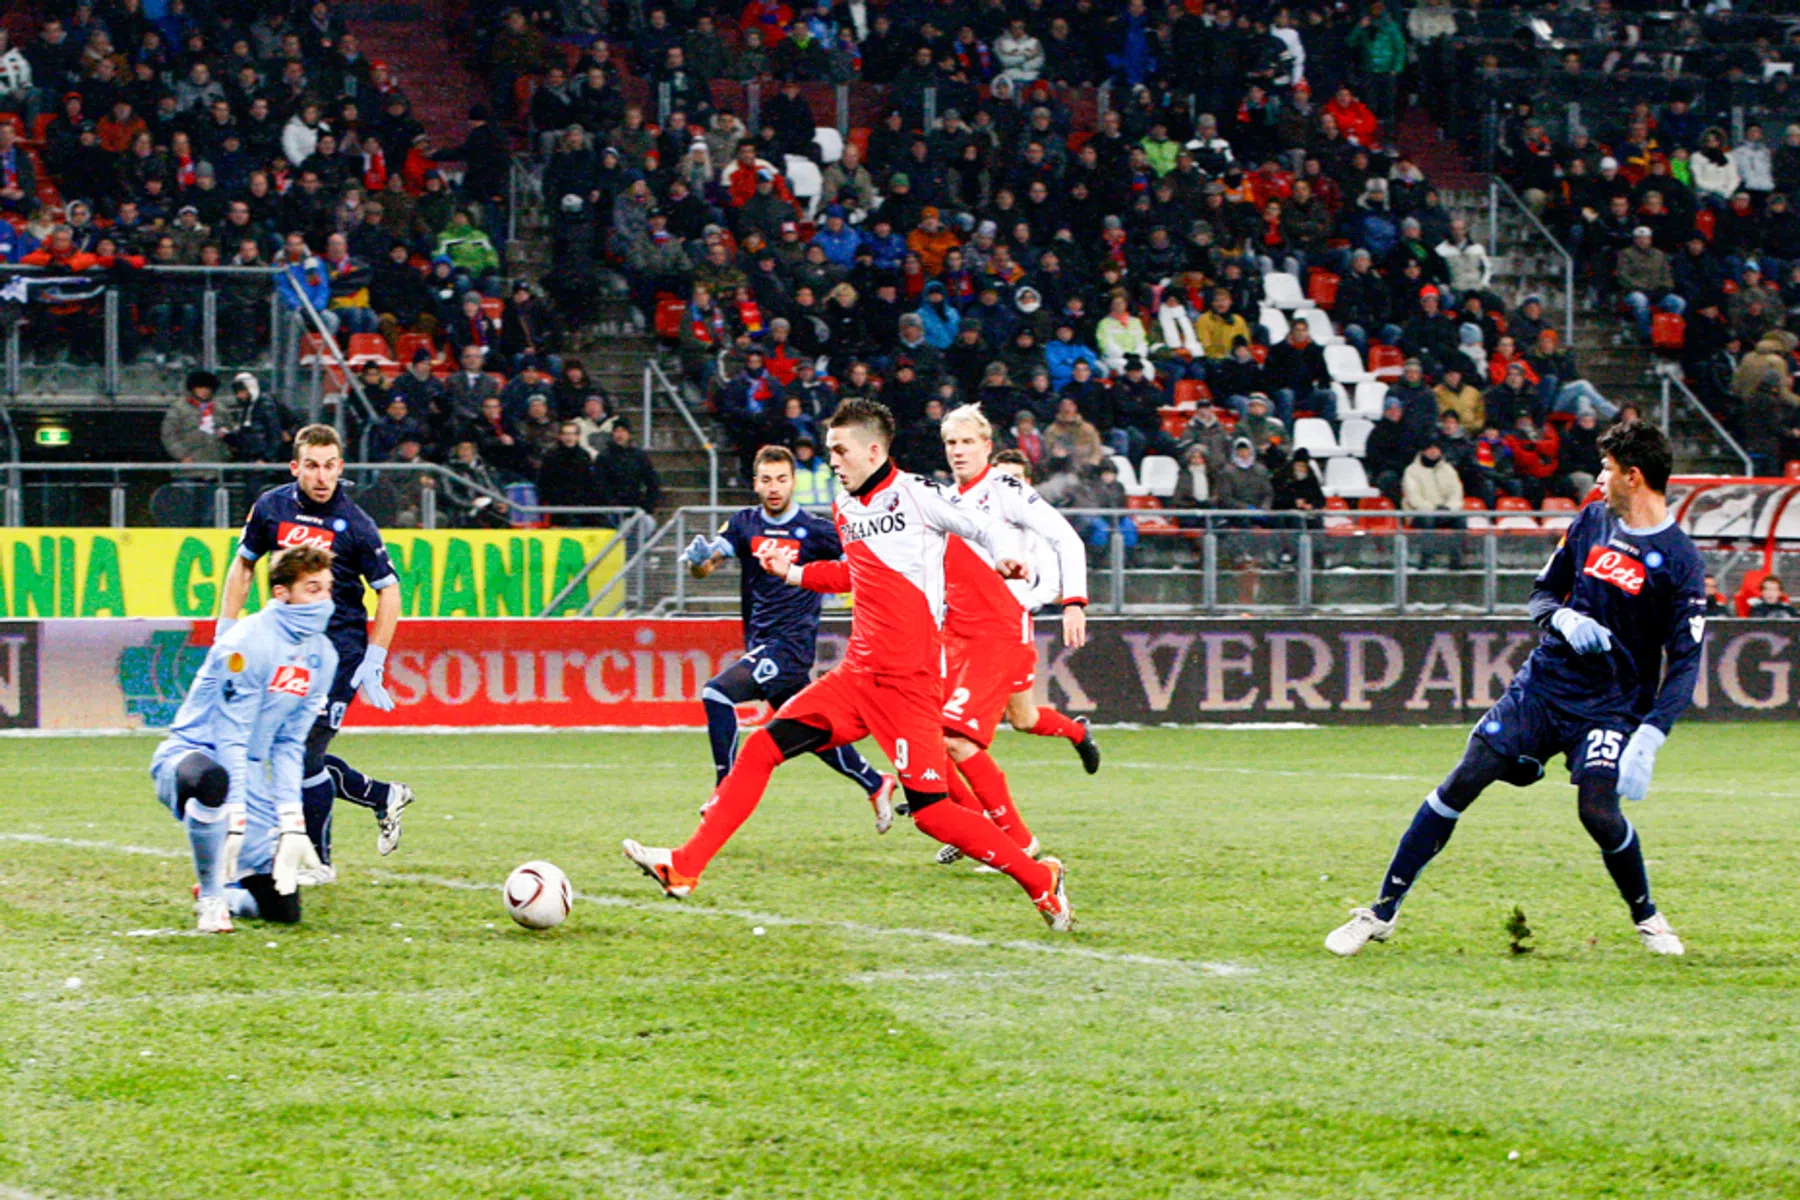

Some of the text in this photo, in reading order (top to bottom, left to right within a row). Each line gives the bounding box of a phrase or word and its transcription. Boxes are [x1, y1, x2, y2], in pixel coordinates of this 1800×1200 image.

[0, 535, 127, 617] NIA
[1583, 551, 1645, 590] Lete
[358, 628, 777, 725] sourcin
[1122, 632, 1800, 709] VERPAKG
[942, 687, 970, 715] 2
[895, 738, 909, 770] 9
[1586, 728, 1623, 760] 25
